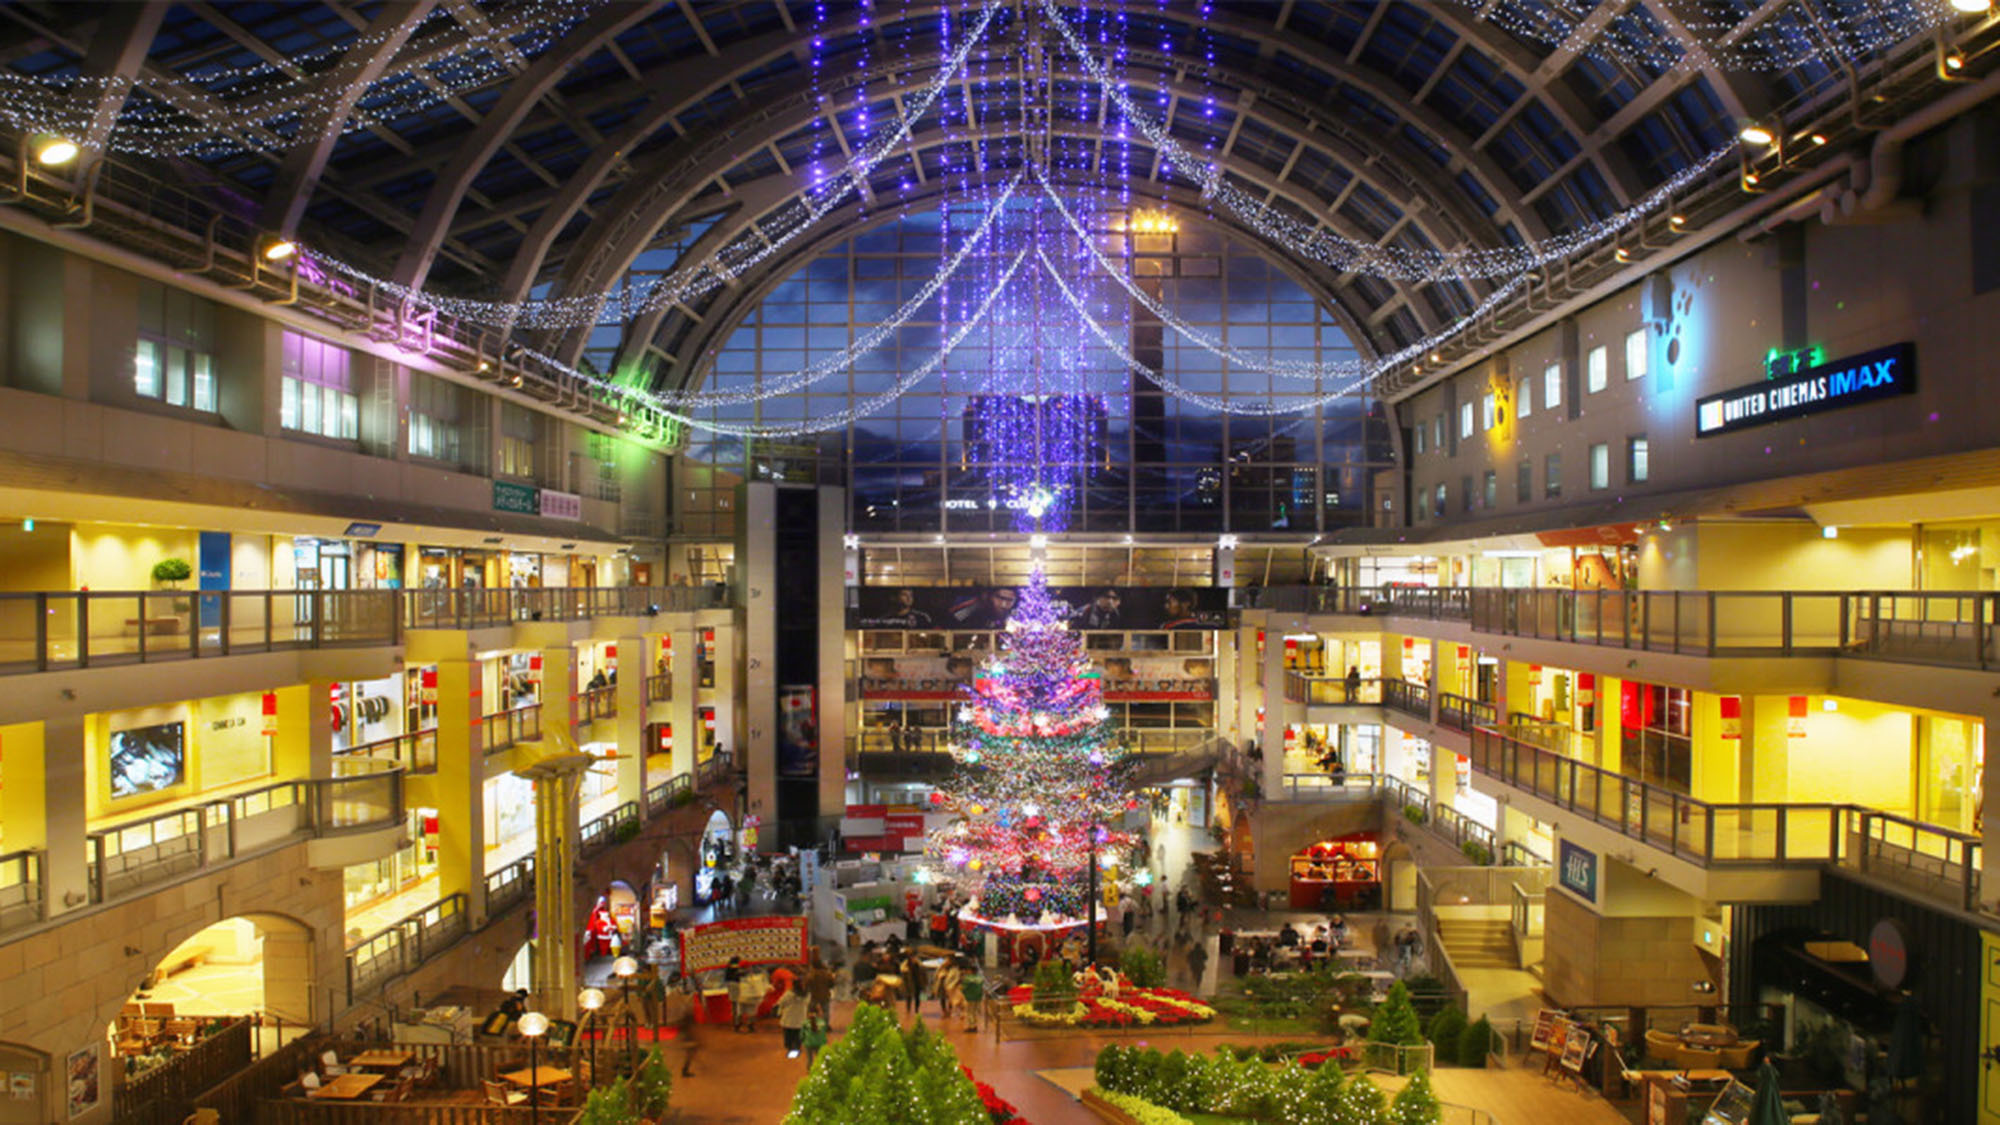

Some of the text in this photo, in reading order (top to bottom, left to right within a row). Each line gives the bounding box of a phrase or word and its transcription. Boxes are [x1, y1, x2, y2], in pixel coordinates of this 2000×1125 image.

[1725, 358, 1896, 422] UNITED CINEMAS IMAX
